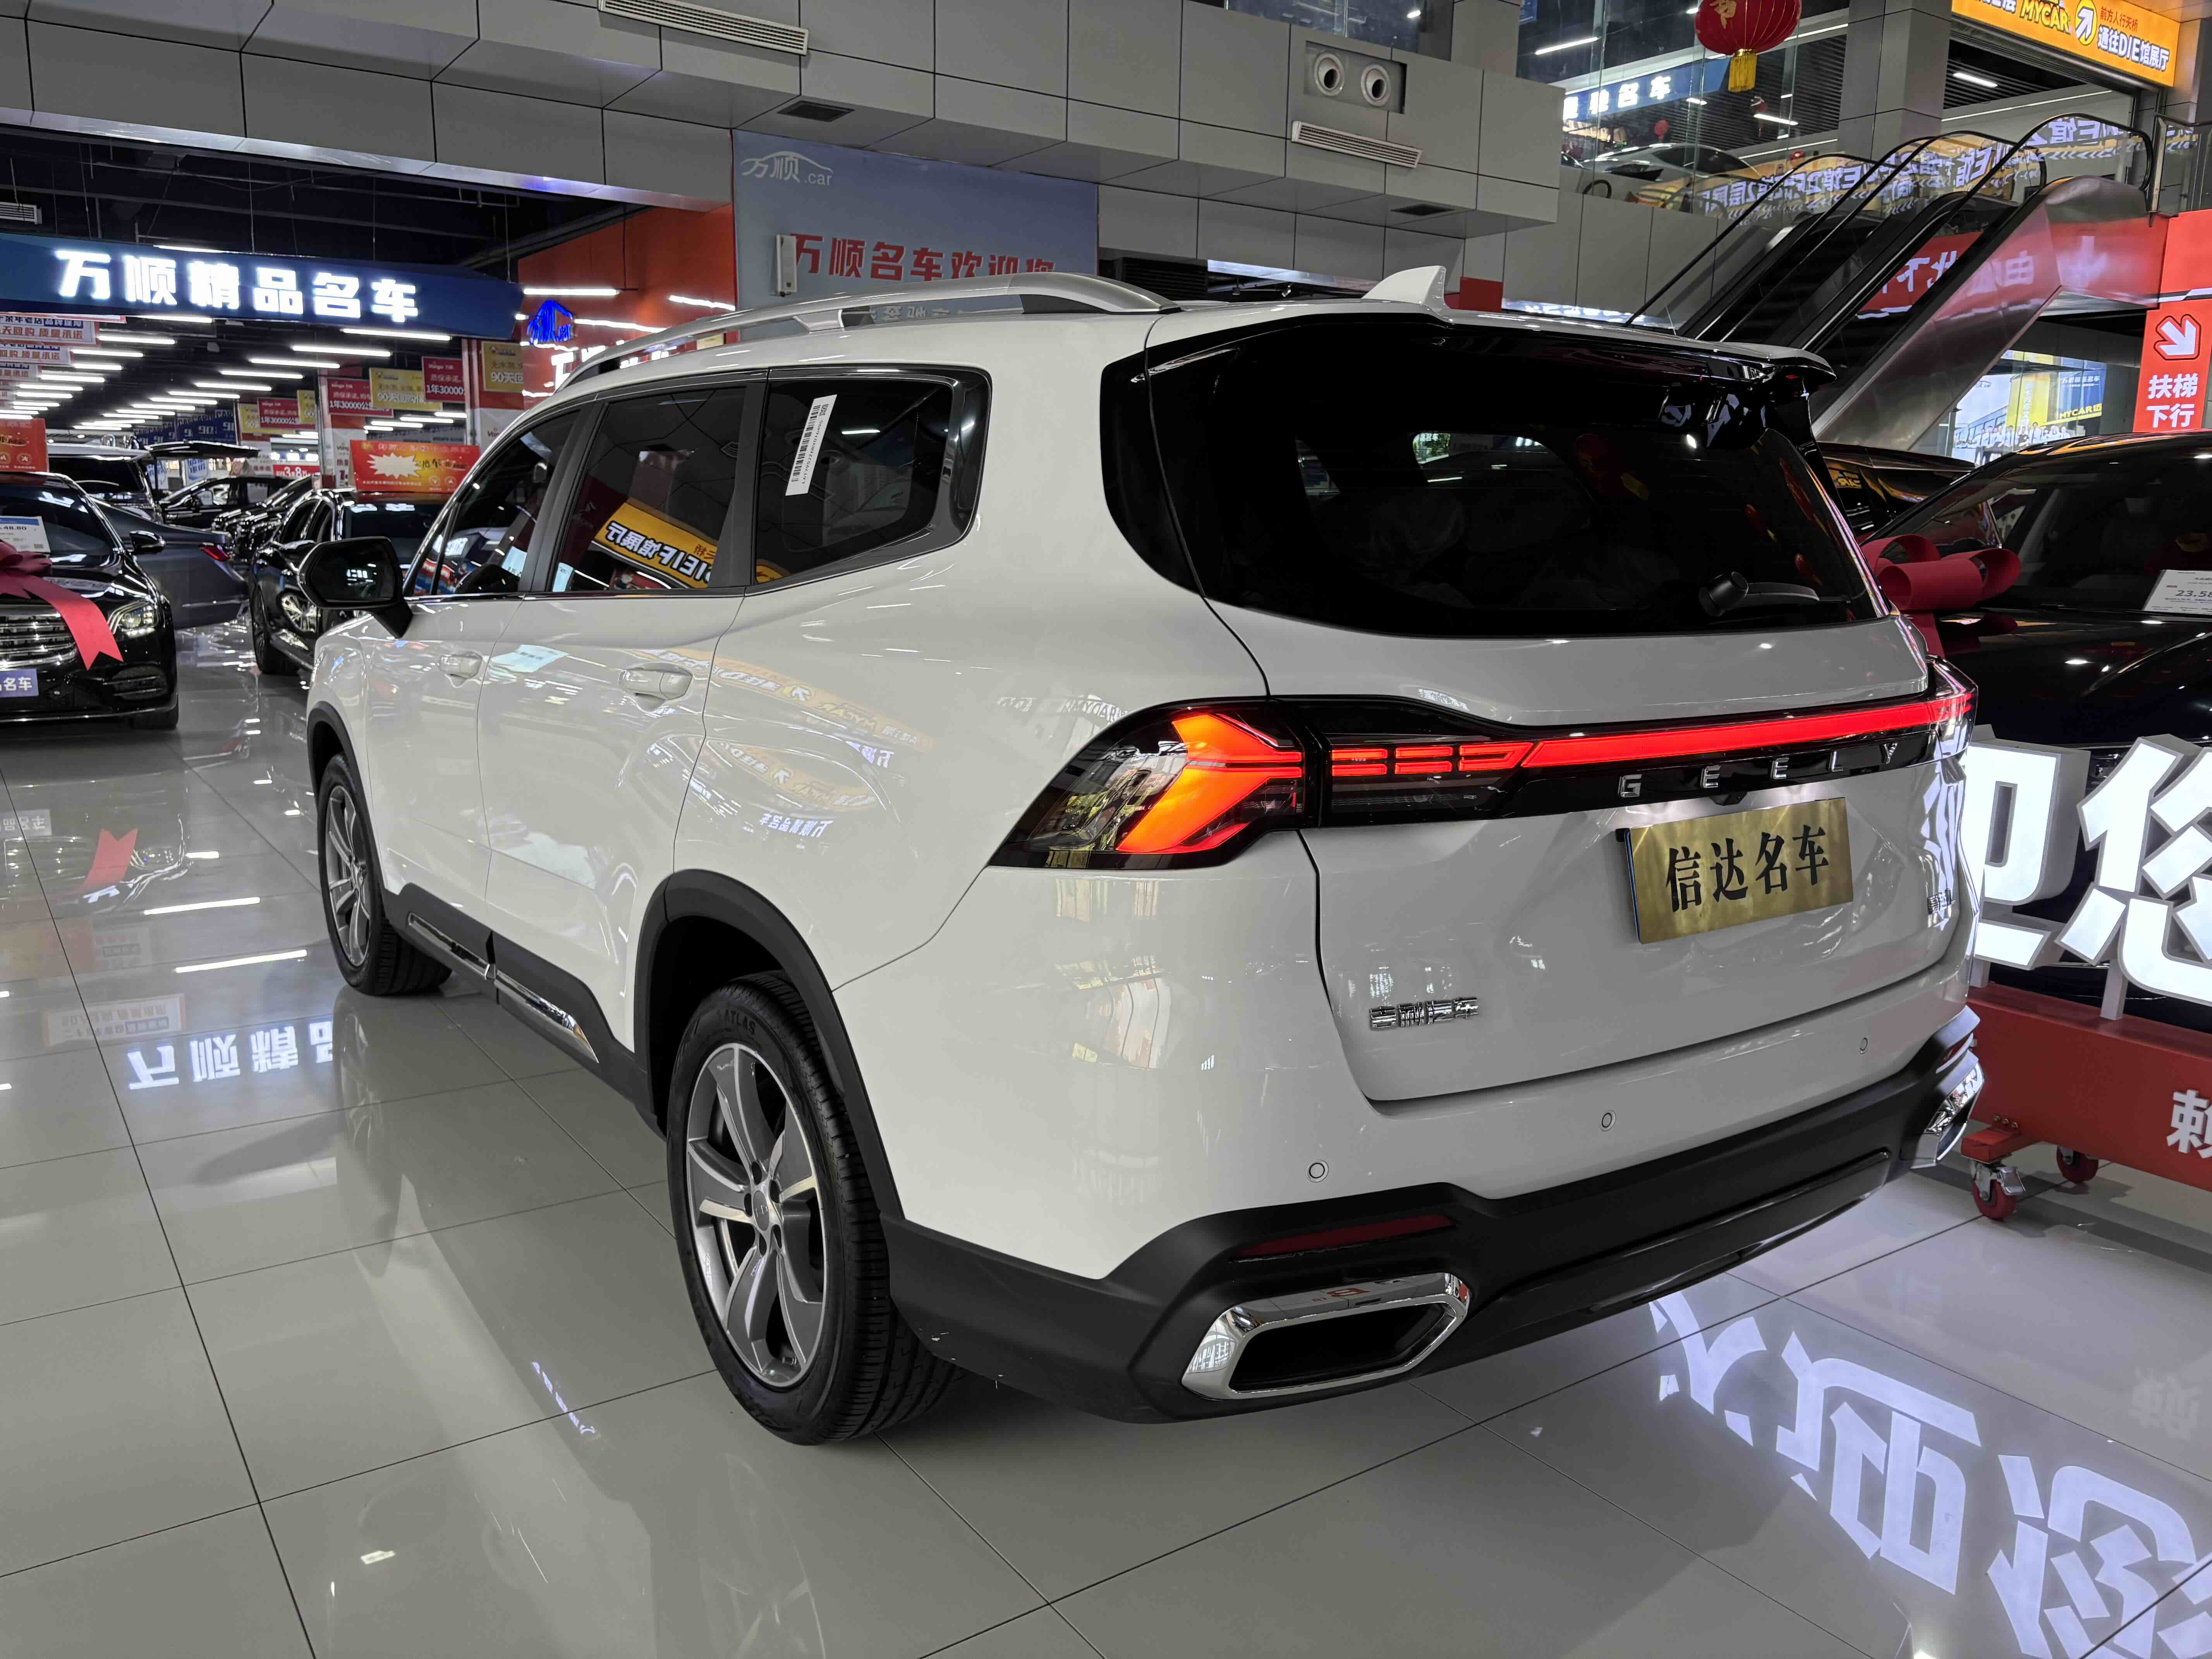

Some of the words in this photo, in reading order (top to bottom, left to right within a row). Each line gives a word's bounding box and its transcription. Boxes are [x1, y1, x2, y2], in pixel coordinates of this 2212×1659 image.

[2100, 7, 2138, 31] 前方人行天桥
[55, 250, 419, 323] 万顺精品名车
[2148, 373, 2198, 399] 扶梯
[2146, 403, 2195, 428] 下行
[0, 677, 33, 691] 名车
[1618, 742, 1898, 798] GEELY
[1666, 824, 1829, 912] 信达名车
